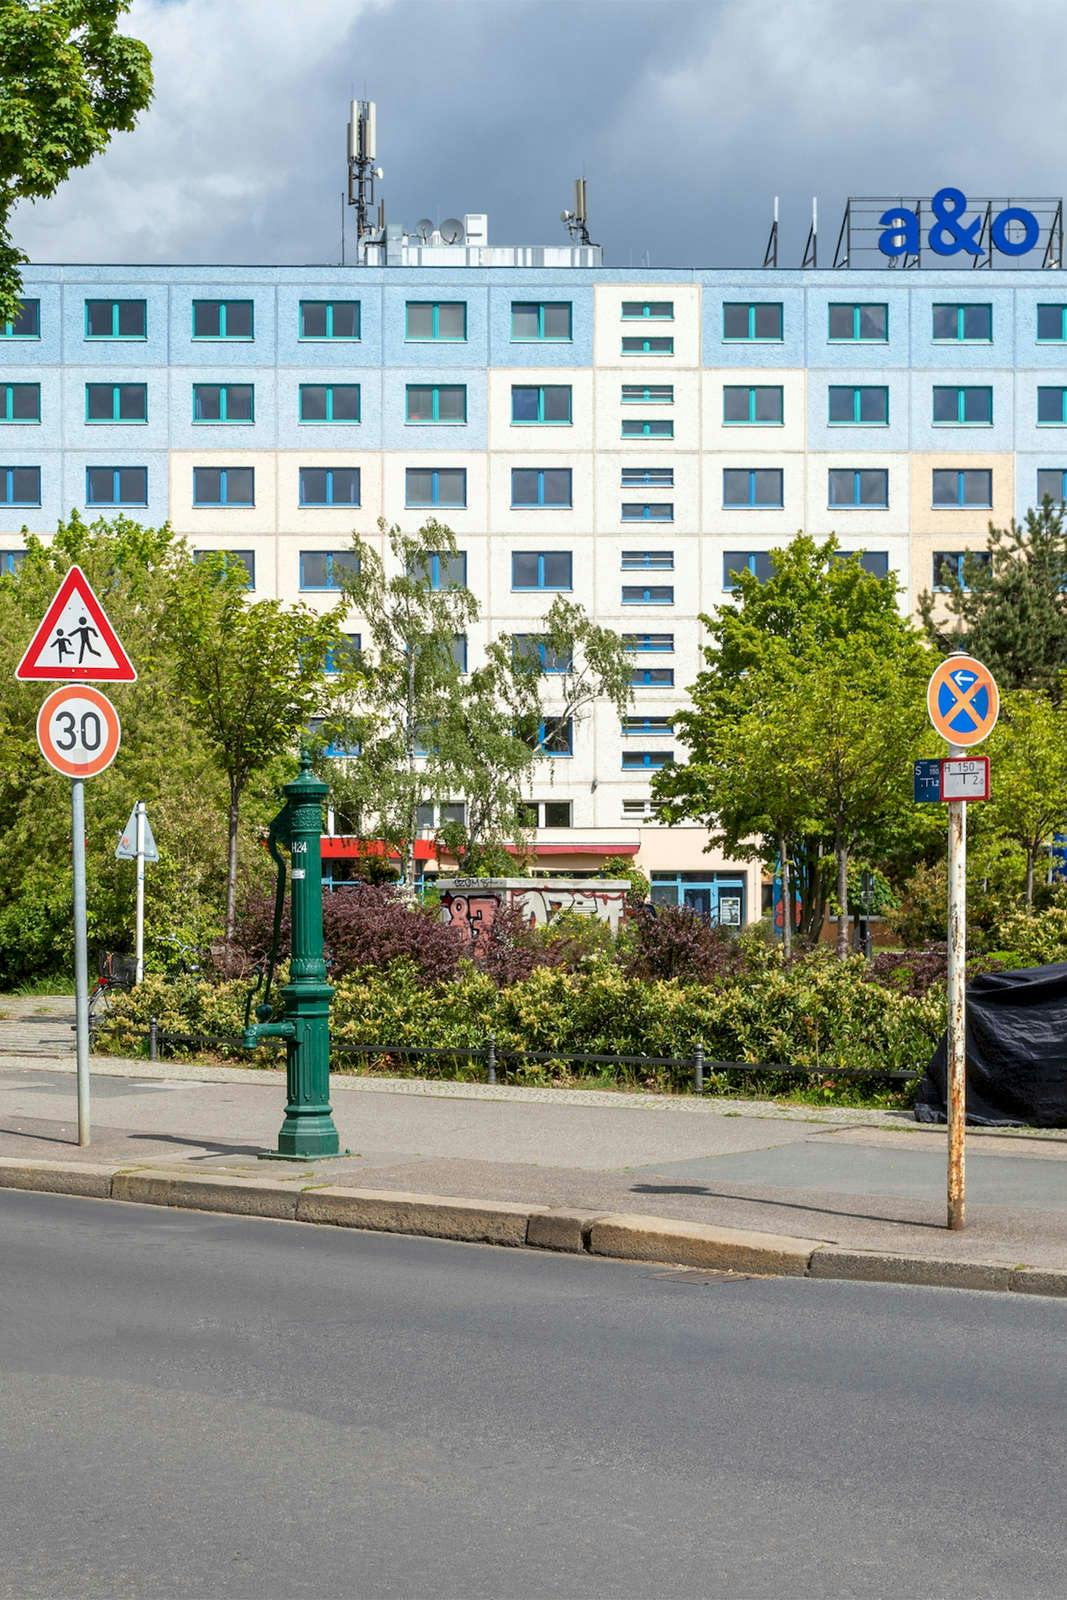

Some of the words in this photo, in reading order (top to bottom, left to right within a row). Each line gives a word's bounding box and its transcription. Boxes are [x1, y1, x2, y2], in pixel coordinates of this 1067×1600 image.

[878, 187, 1040, 257] a&o
[55, 711, 101, 751] 30
[915, 765, 922, 776] S
[944, 762, 951, 773] H
[958, 762, 975, 773] 150
